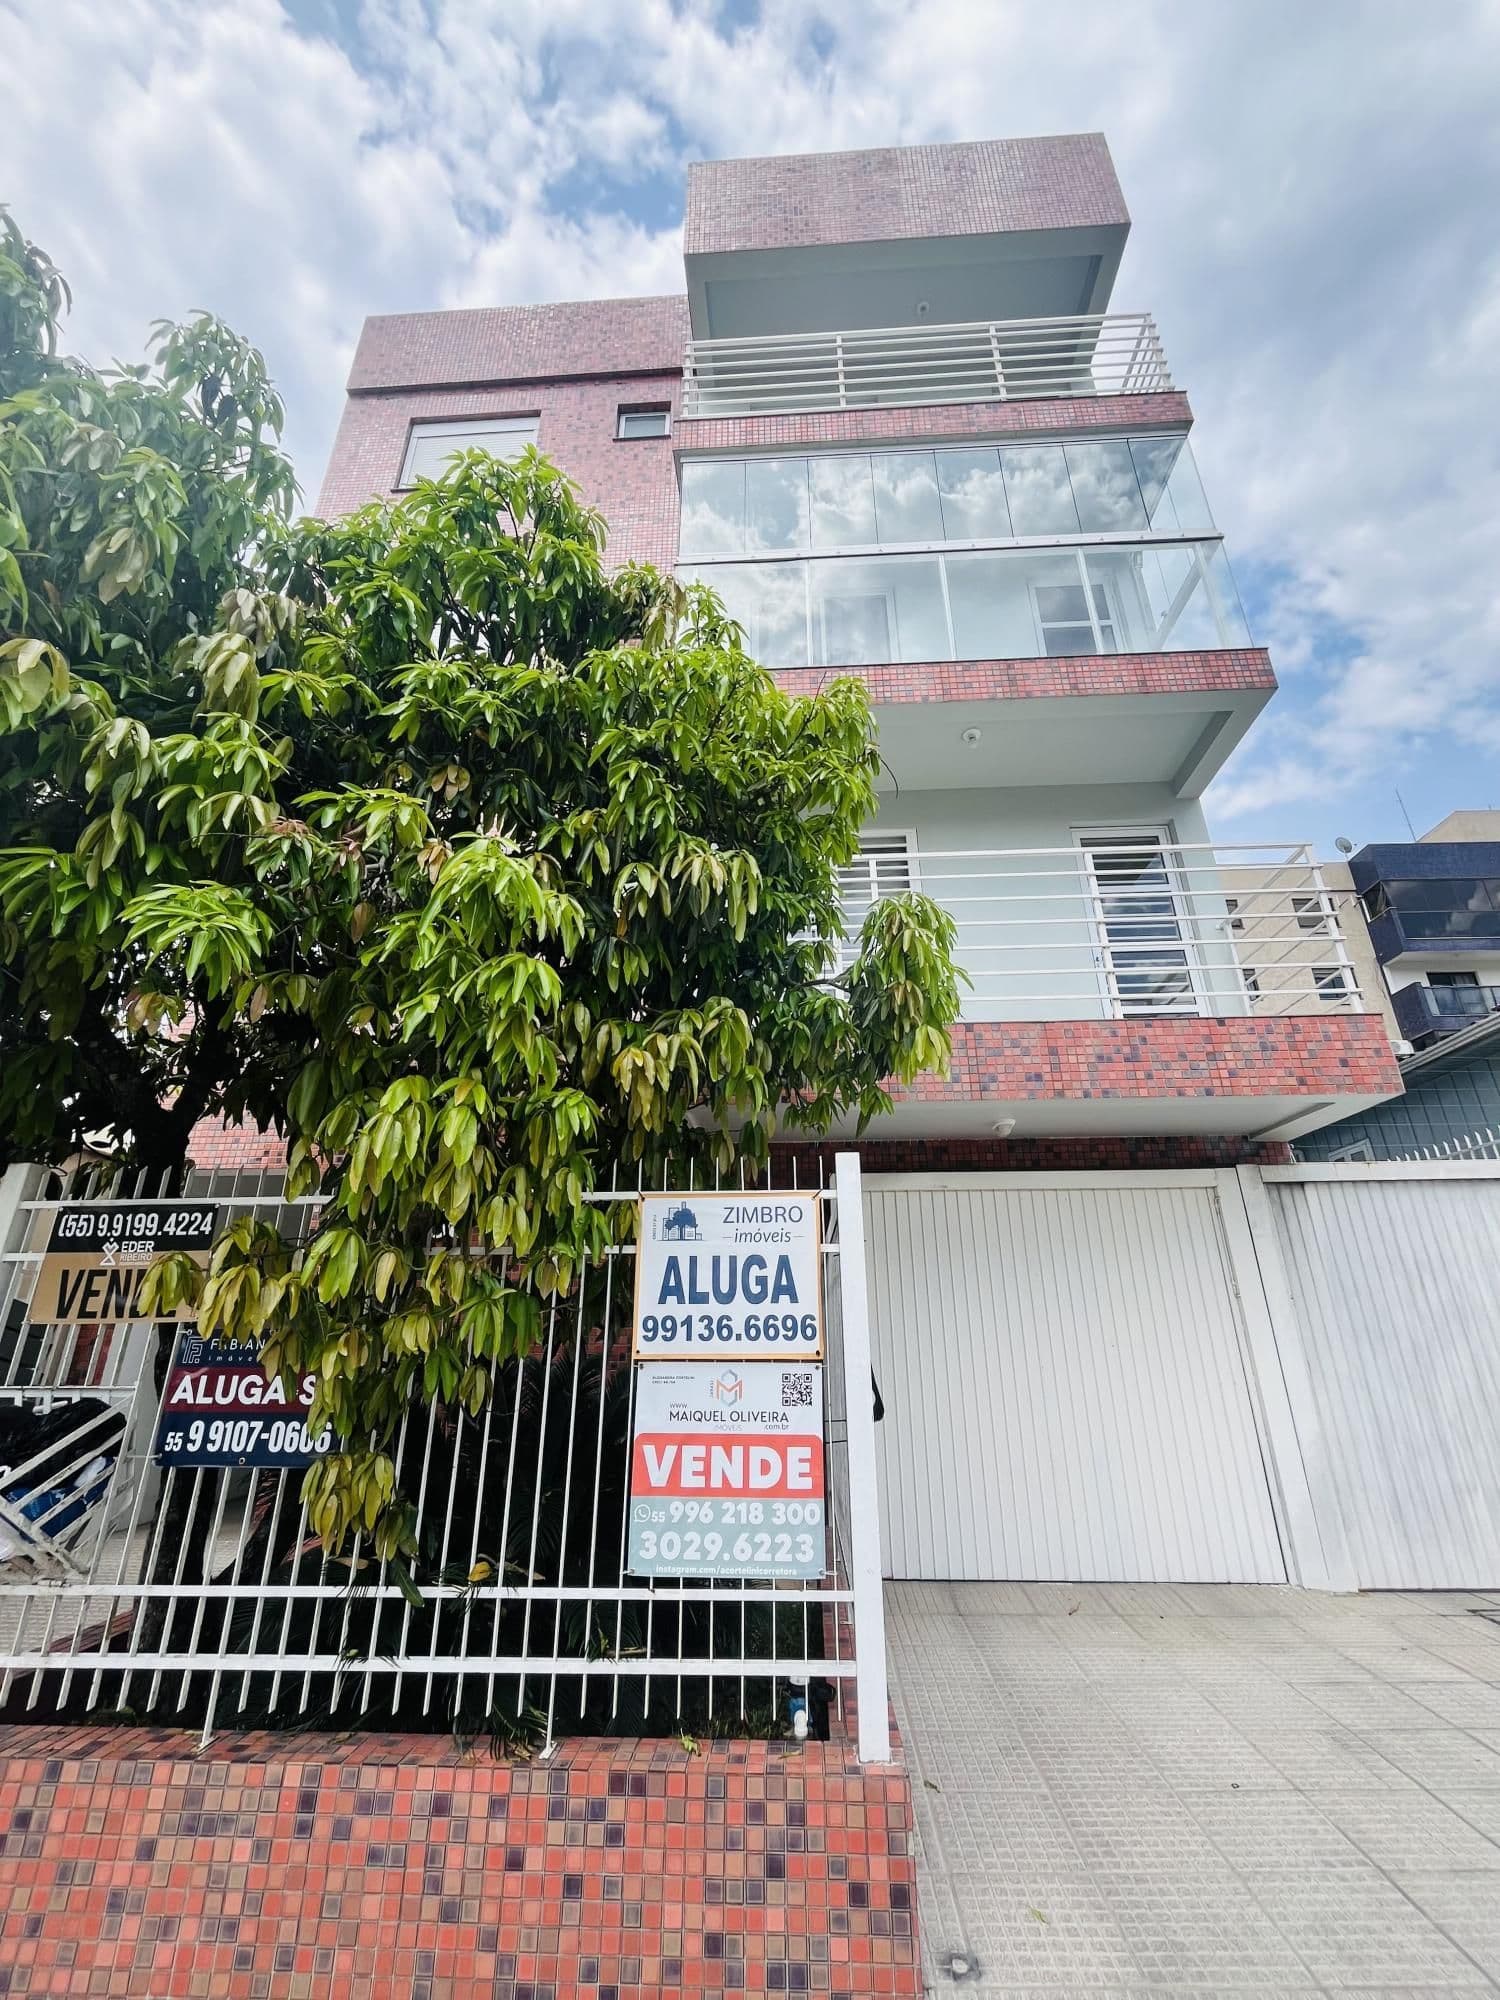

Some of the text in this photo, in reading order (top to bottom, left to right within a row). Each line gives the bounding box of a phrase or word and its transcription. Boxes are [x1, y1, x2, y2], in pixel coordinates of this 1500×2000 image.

[58, 1212, 213, 1237] (55) 9.9199.4224
[723, 1205, 803, 1223] ZIMBRO
[121, 1241, 155, 1252] EDER
[734, 1228, 791, 1243] imóveis
[119, 1253, 153, 1261] RIBEIRO
[658, 1254, 799, 1305] ALUGA
[642, 1314, 817, 1342] 99136.6696
[669, 1410, 789, 1423] MAIQUEL OLIVEIRA
[165, 1432, 183, 1451] 55
[187, 1420, 205, 1452] 9
[642, 1444, 813, 1490] VENDE
[651, 1501, 820, 1526] 55 996 218 300
[639, 1531, 815, 1563] 3029.6223
